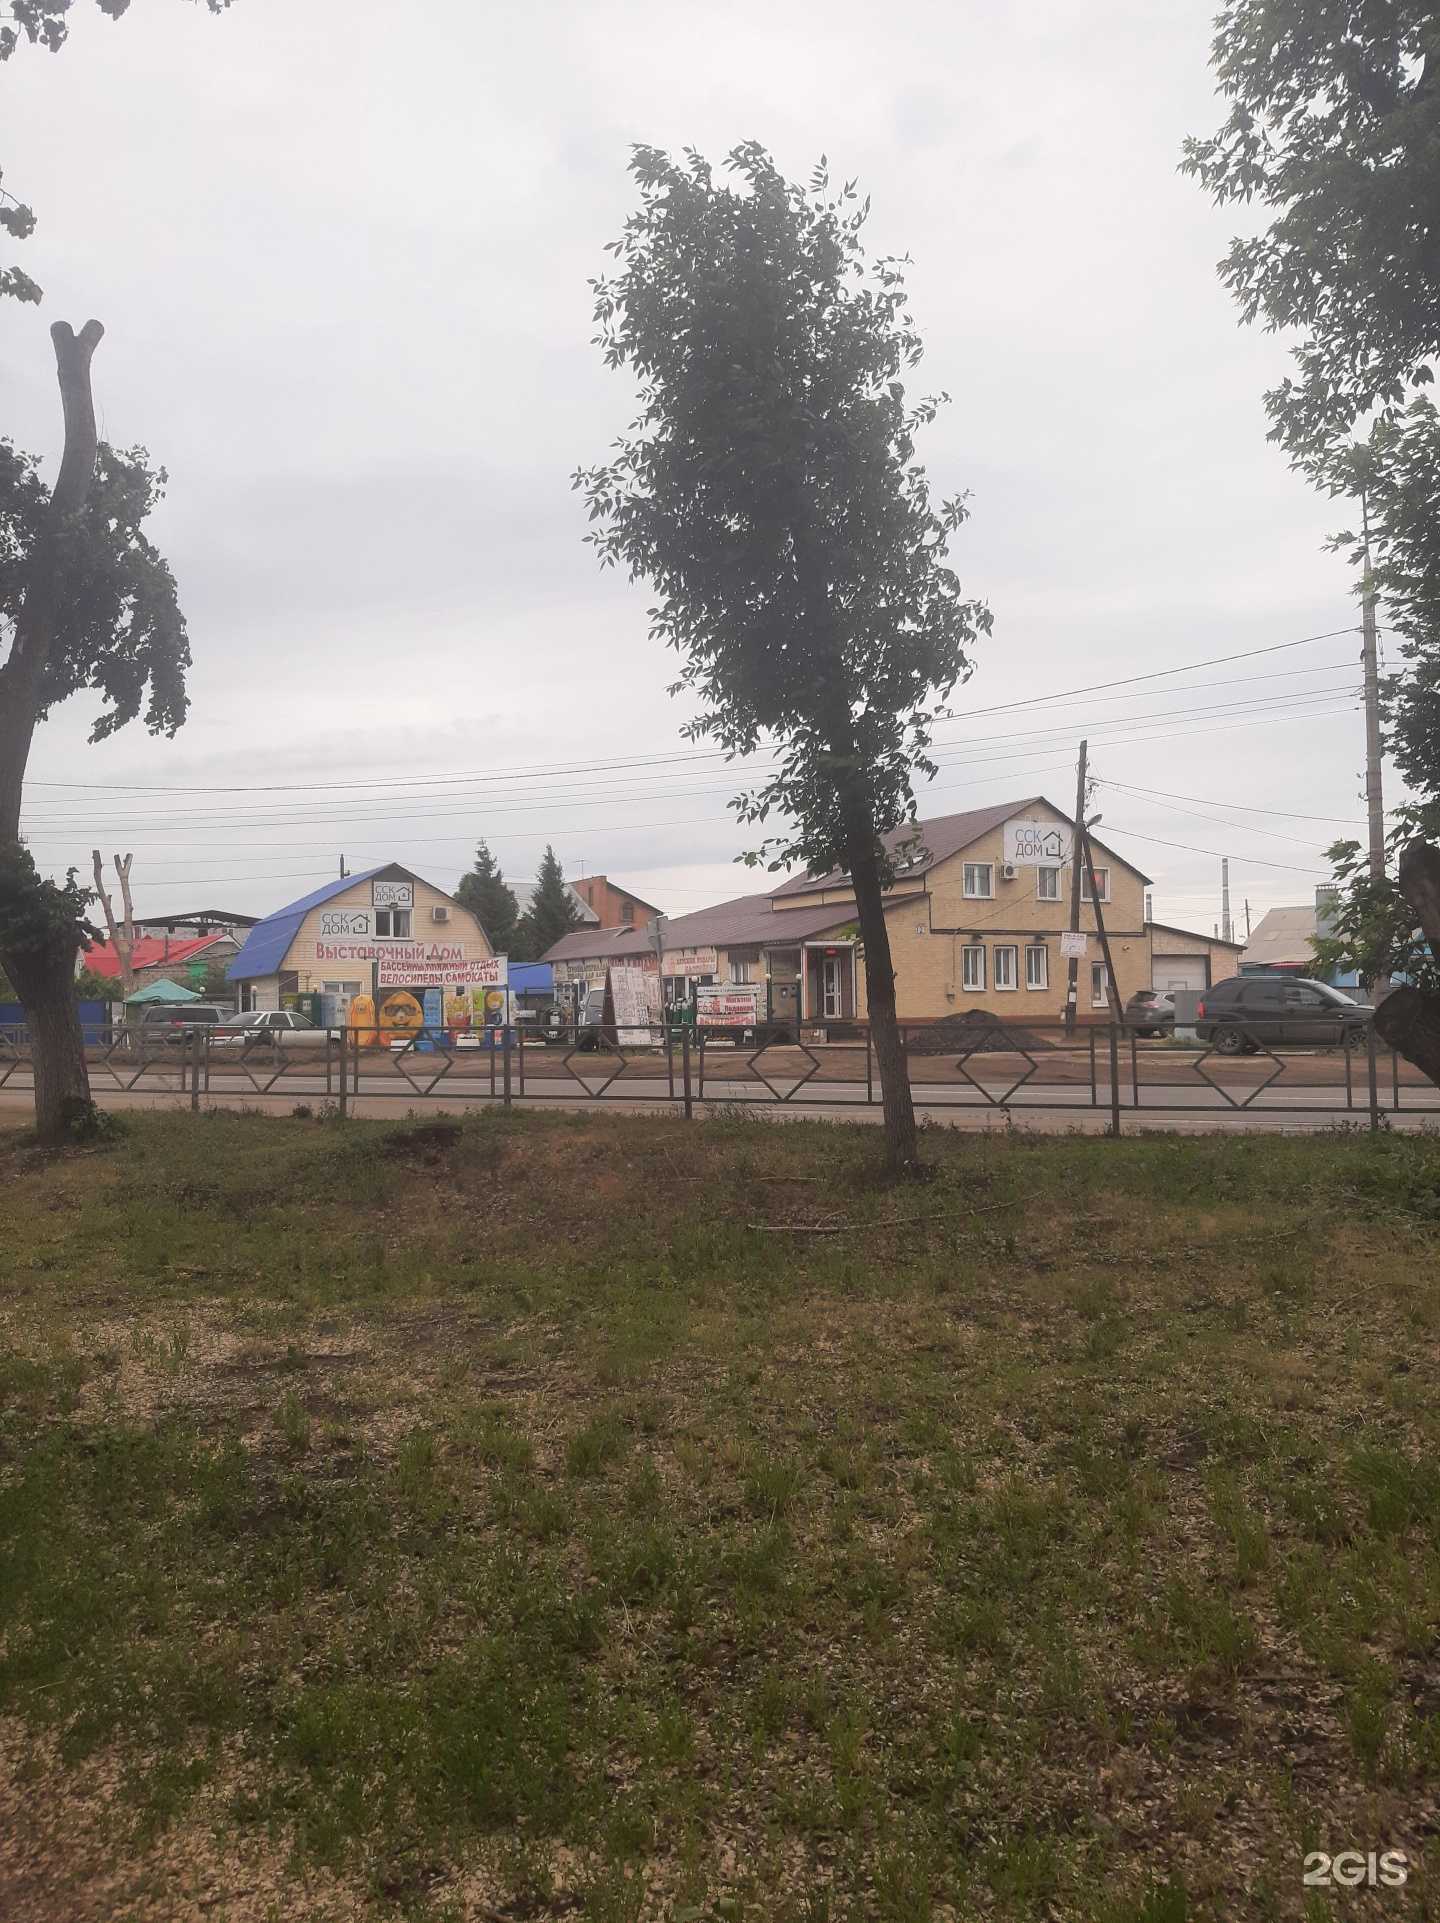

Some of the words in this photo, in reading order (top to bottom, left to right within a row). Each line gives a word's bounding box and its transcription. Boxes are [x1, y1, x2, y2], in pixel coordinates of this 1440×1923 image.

[1015, 829, 1042, 843] ССК
[1015, 843, 1043, 858] ДОМ
[375, 893, 396, 902] ДОМ
[321, 913, 349, 925] ССК
[321, 924, 350, 937] ДОМ
